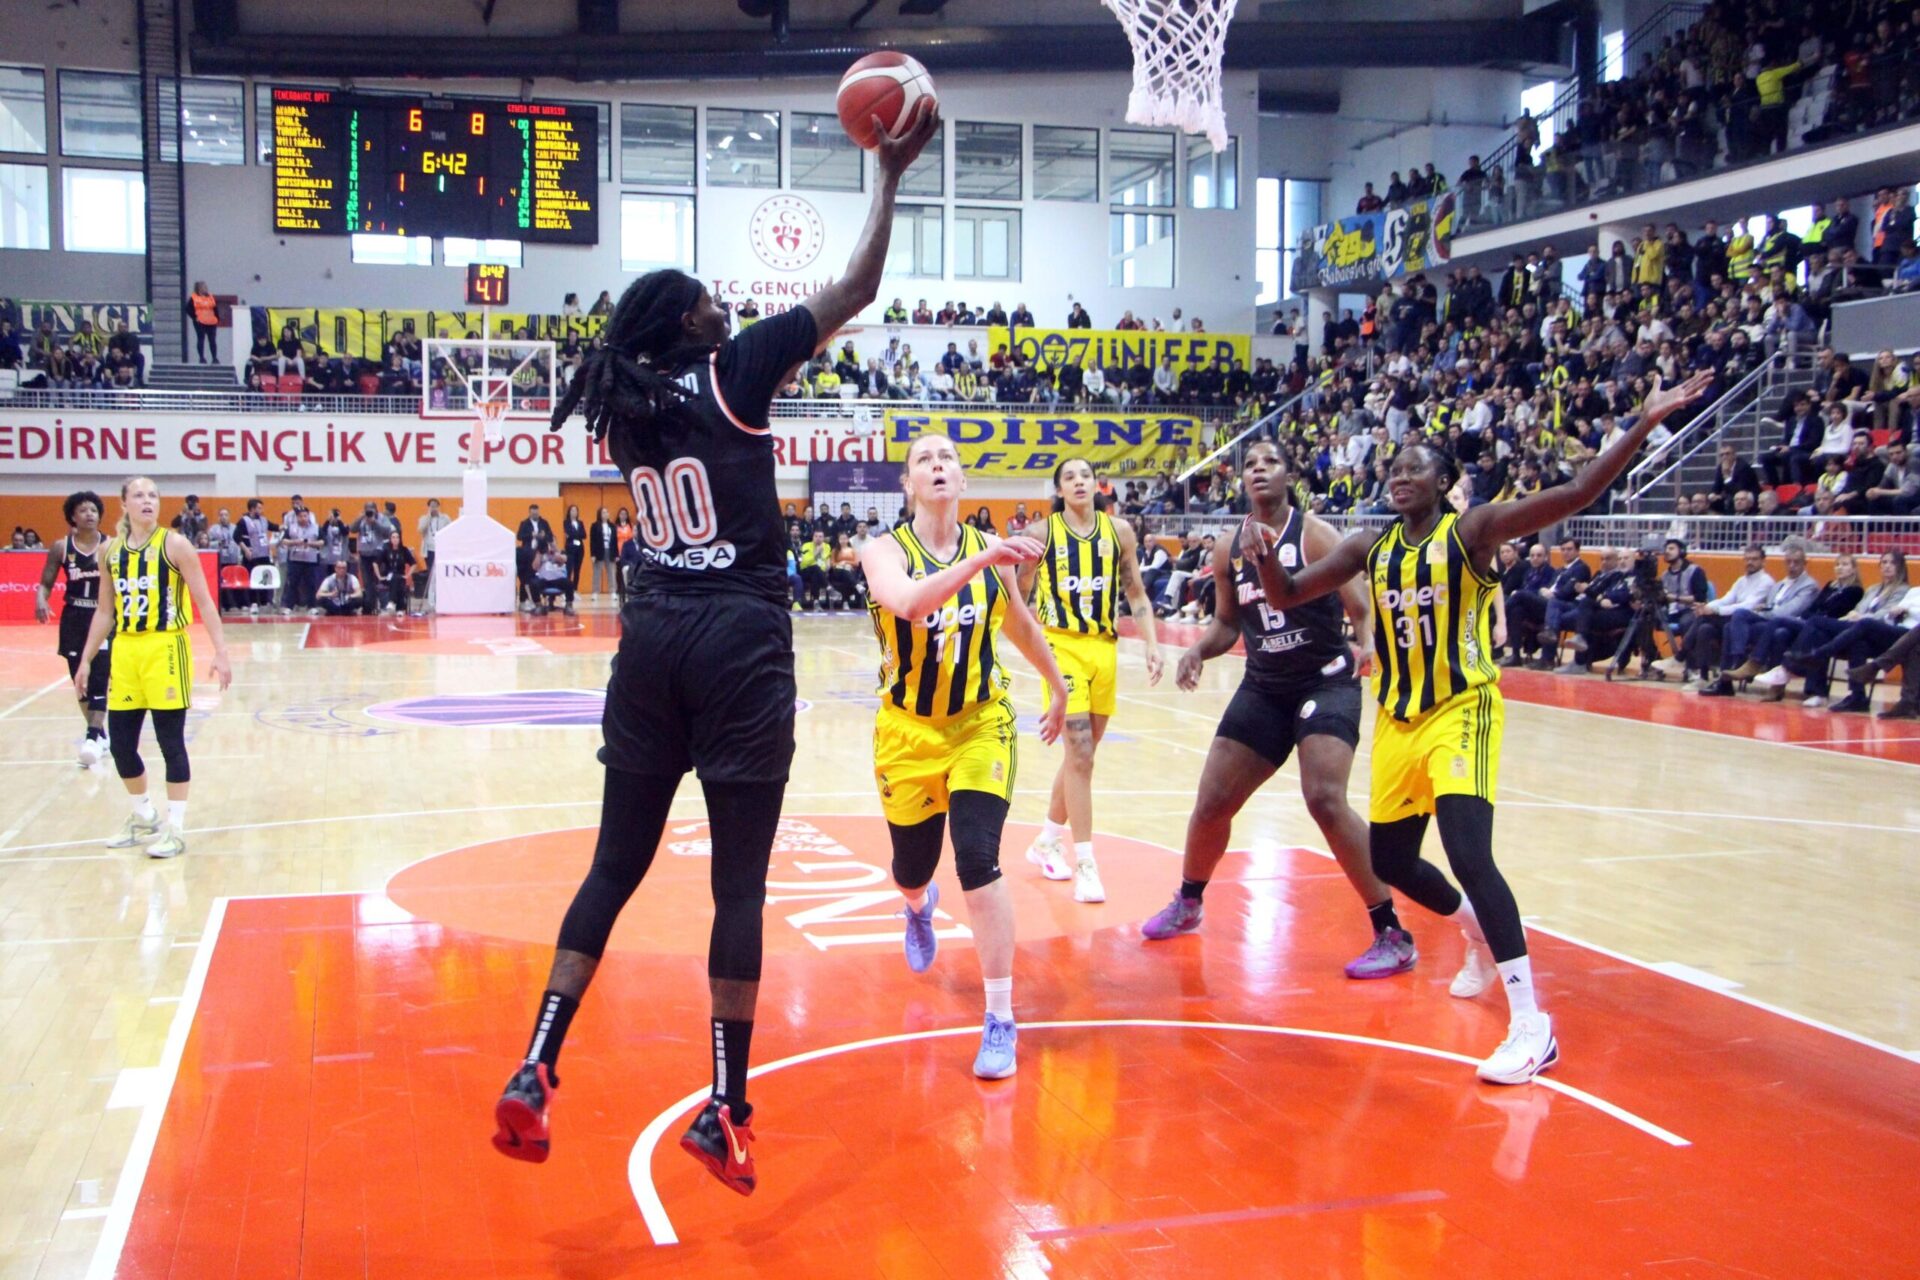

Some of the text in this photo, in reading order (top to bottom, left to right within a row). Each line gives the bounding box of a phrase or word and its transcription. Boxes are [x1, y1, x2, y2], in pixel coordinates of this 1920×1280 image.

[409, 109, 422, 132] 6
[471, 112, 485, 135] 8
[422, 151, 467, 175] 6:42
[712, 279, 745, 295] T.C.
[180, 423, 366, 472] GENÇLİK
[385, 431, 436, 464] VE
[630, 456, 719, 552] 00
[444, 564, 480, 578] ING
[84, 580, 91, 598] 1
[1058, 575, 1112, 594] opet
[123, 594, 149, 617] 22
[1079, 595, 1094, 620] 5
[1382, 583, 1449, 612] opet
[915, 601, 988, 631] opet
[1257, 602, 1286, 632] 15
[1396, 614, 1434, 648] 31
[933, 631, 962, 664] 11
